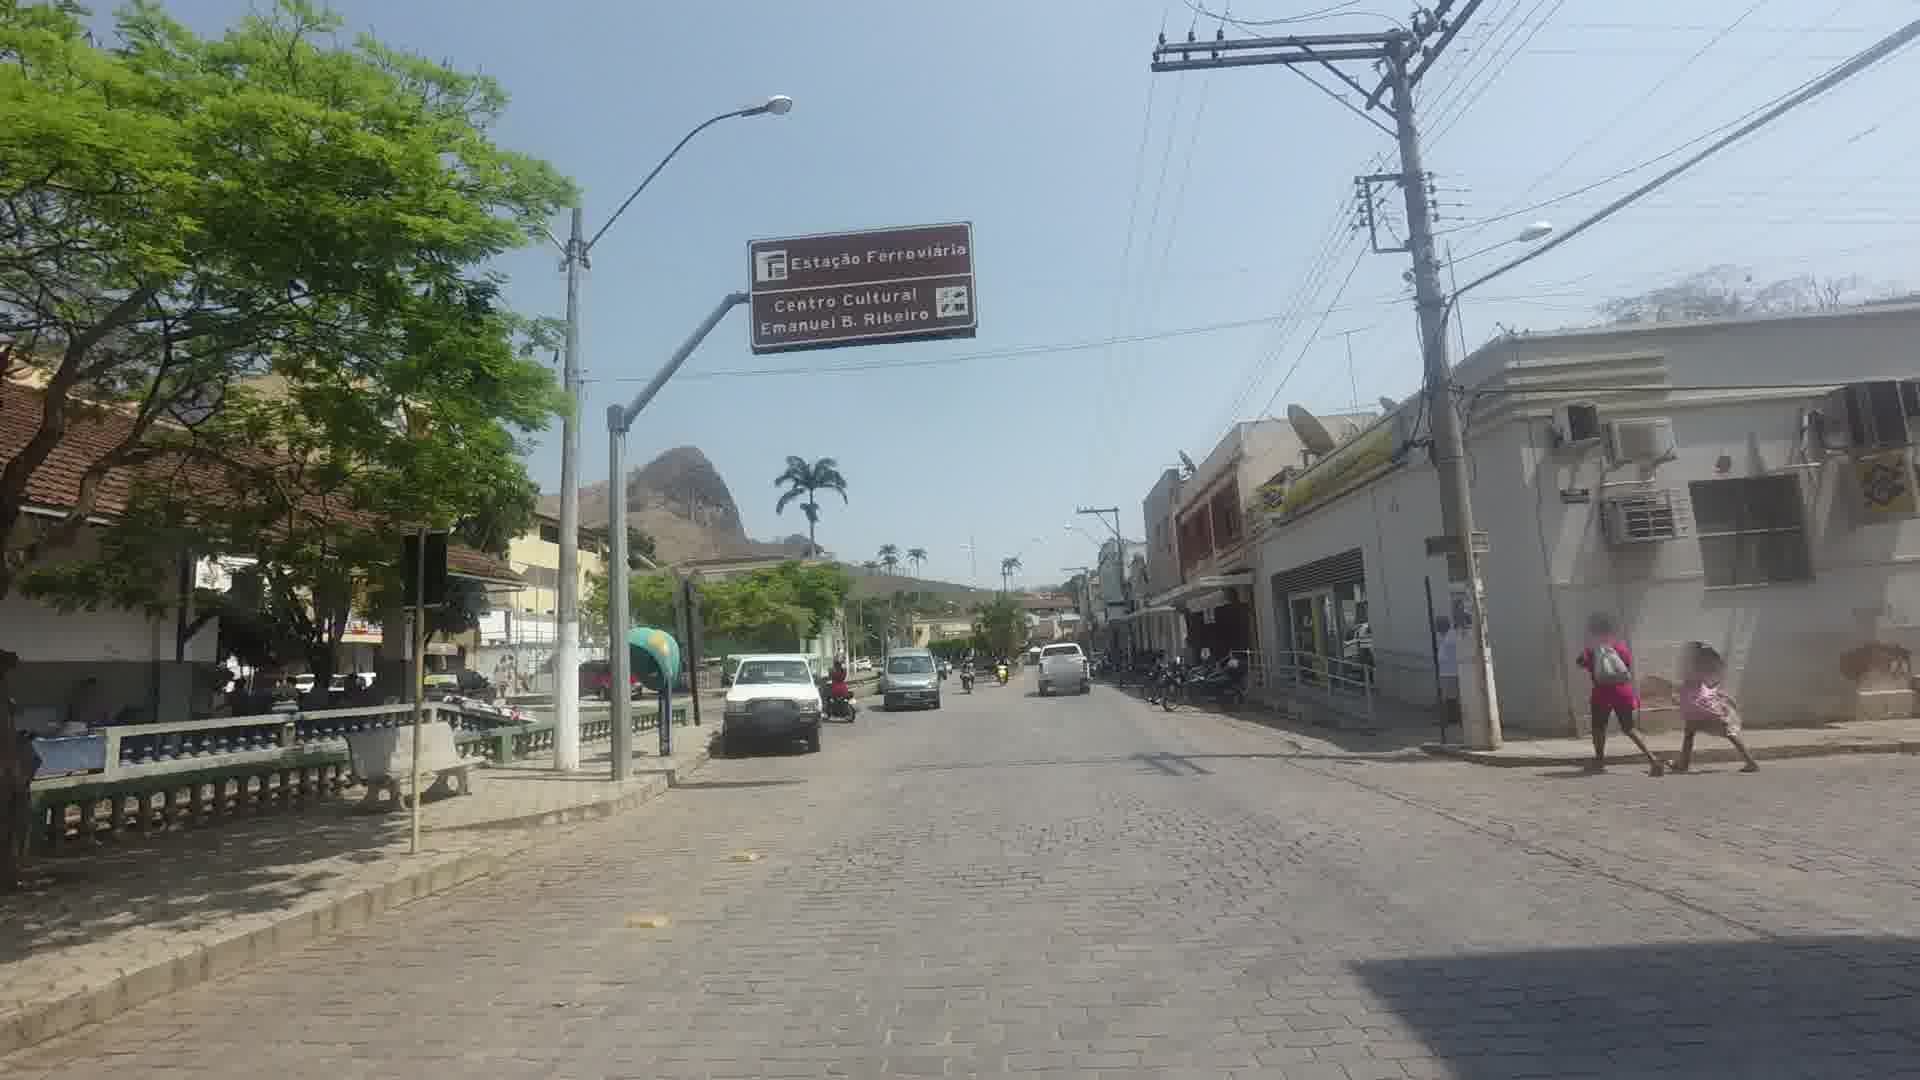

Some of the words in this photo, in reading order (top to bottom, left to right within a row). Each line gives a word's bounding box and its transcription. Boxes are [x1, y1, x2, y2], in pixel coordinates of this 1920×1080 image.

[791, 252, 860, 270] Estação
[774, 293, 836, 313] Centro
[842, 287, 917, 307] Cultural
[761, 315, 836, 335] Emanuel
[864, 310, 929, 327] Ribeiro
